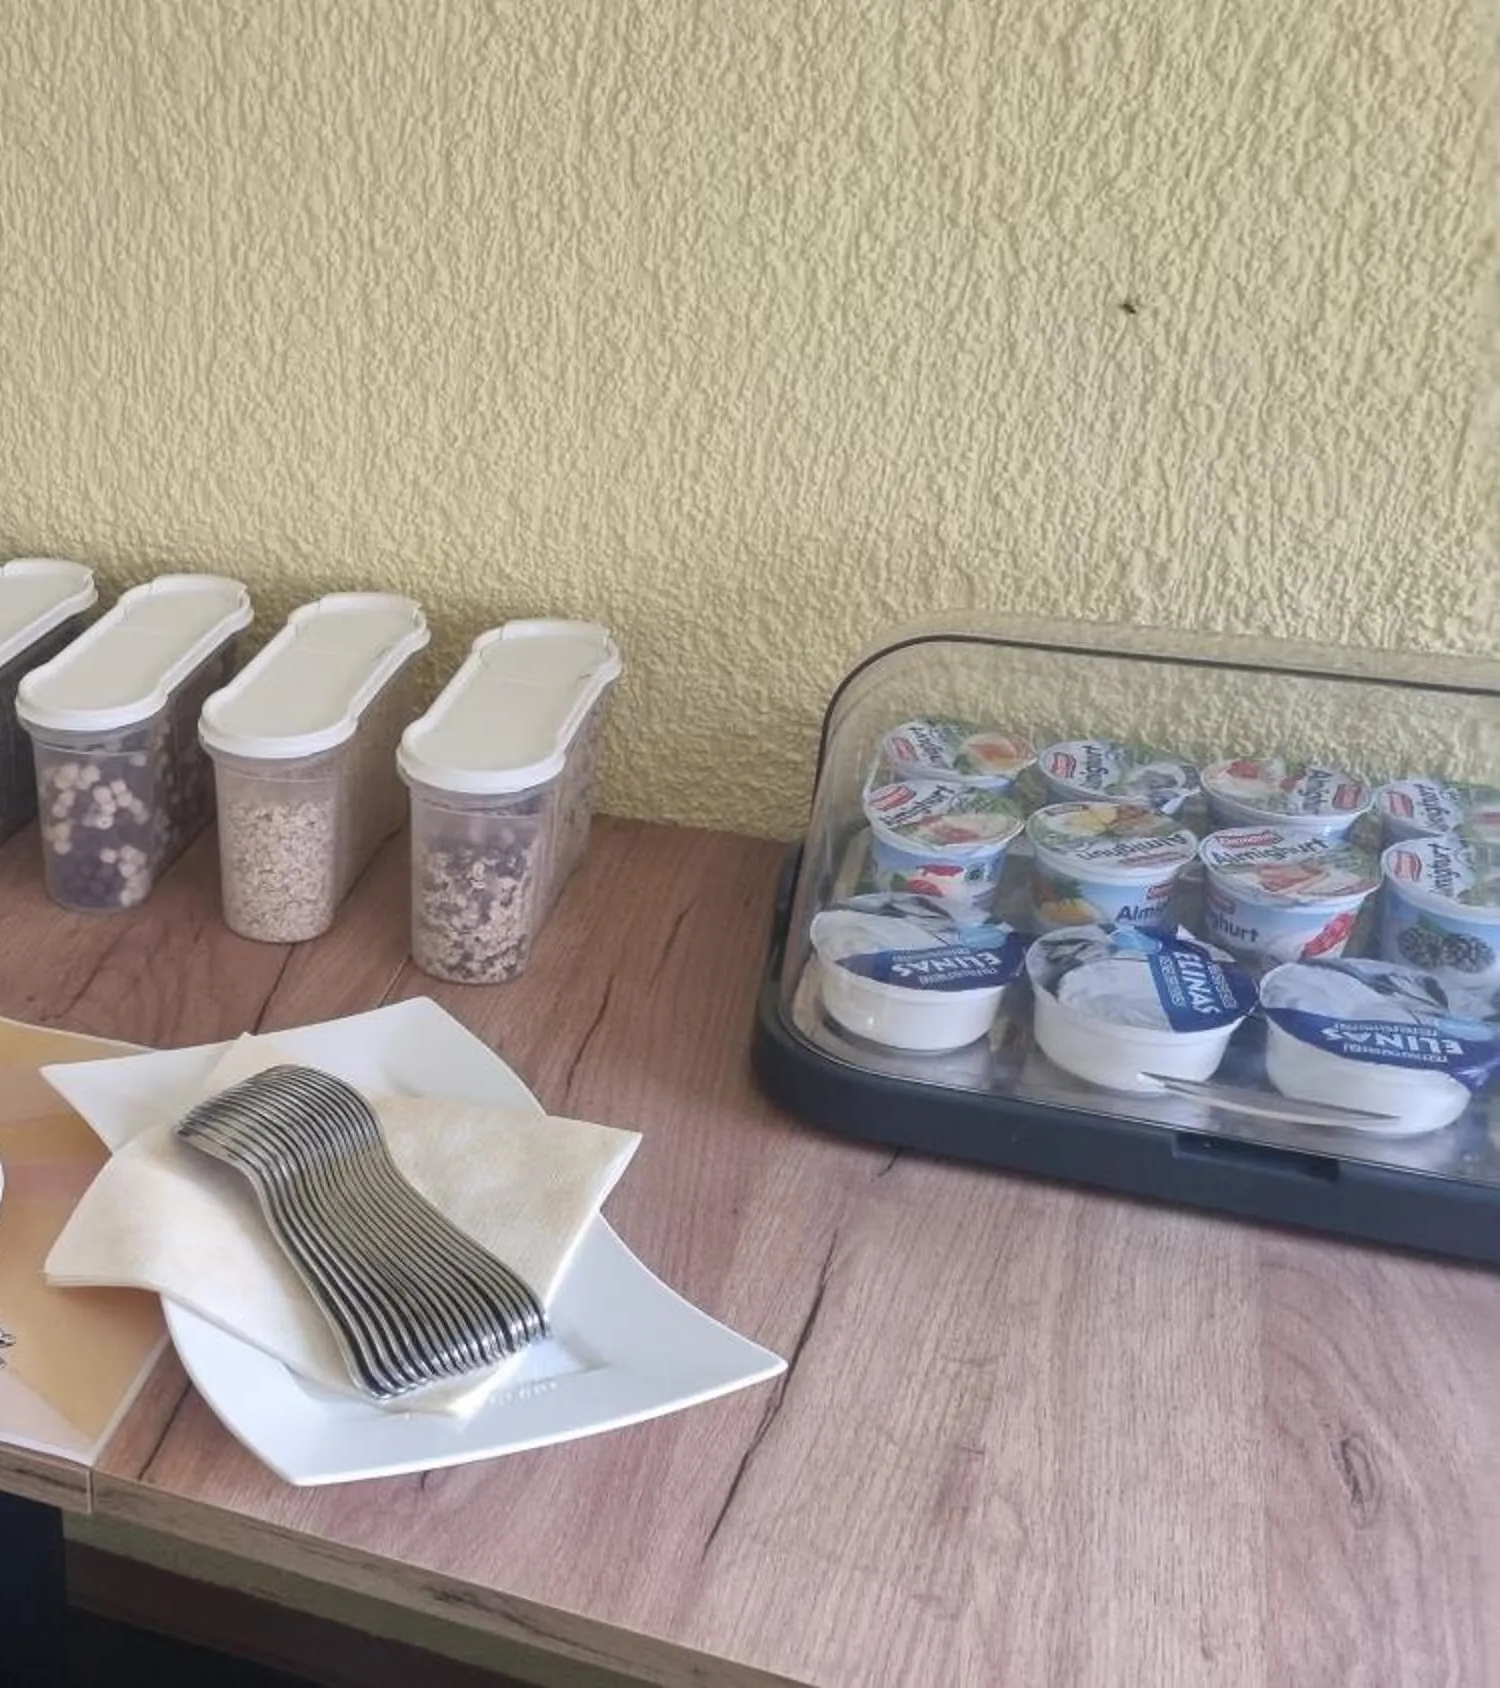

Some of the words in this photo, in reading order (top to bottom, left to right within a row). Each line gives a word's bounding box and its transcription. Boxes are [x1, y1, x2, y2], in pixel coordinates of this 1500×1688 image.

[891, 951, 1003, 977] ELINAS
[1173, 951, 1221, 1013] ELINAS
[1320, 1027, 1465, 1055] ELINAS
